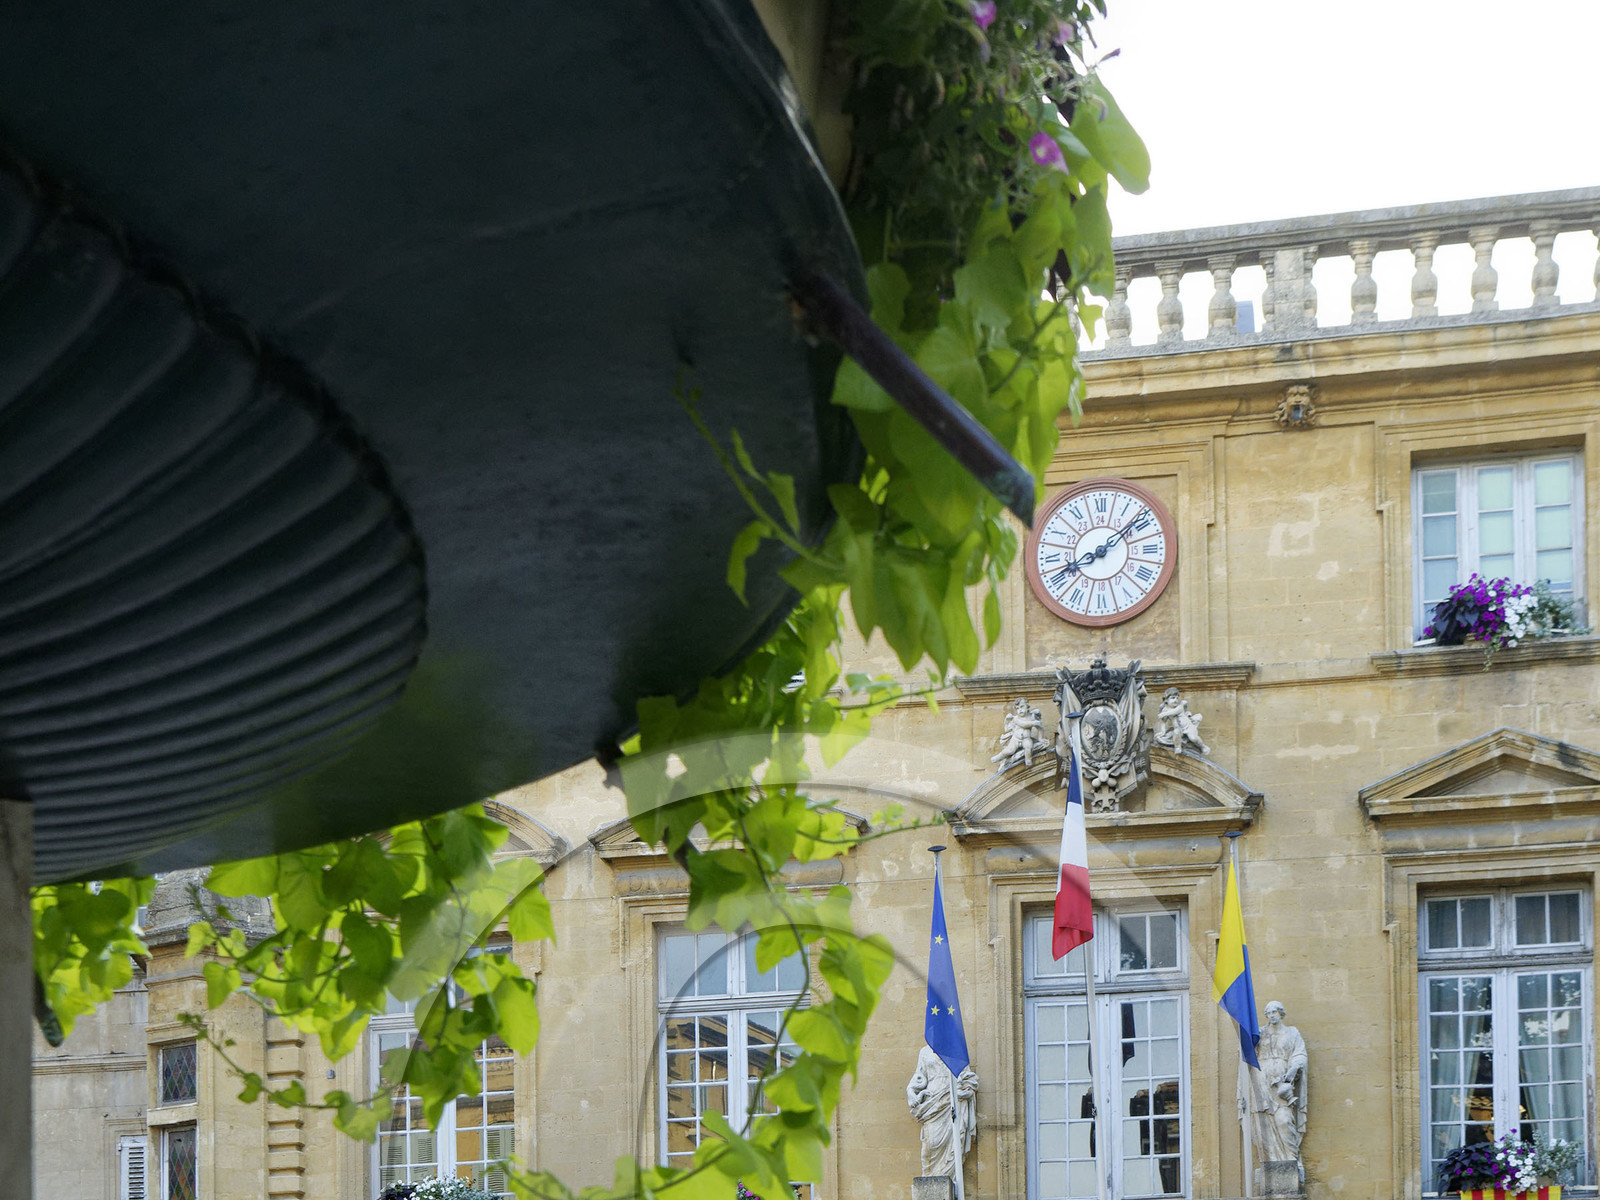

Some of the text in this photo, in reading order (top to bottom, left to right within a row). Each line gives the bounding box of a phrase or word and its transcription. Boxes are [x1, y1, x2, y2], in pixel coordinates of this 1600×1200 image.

[1094, 497, 1107, 513] XII
[1096, 515, 1105, 526] 24
[1113, 518, 1121, 527] 13
[1135, 519, 1150, 532] II
[1077, 521, 1088, 531] 23
[1067, 535, 1076, 544] 22
[1131, 546, 1138, 555] 15
[1142, 544, 1158, 554] III
[1064, 551, 1072, 561] 21
[1126, 563, 1134, 572] 16
[1134, 565, 1154, 582] IIII
[1081, 579, 1089, 588] 19
[1114, 576, 1122, 585] 17
[1098, 582, 1105, 591] 18
[1069, 588, 1084, 606] VII
[1096, 593, 1107, 609] VI
